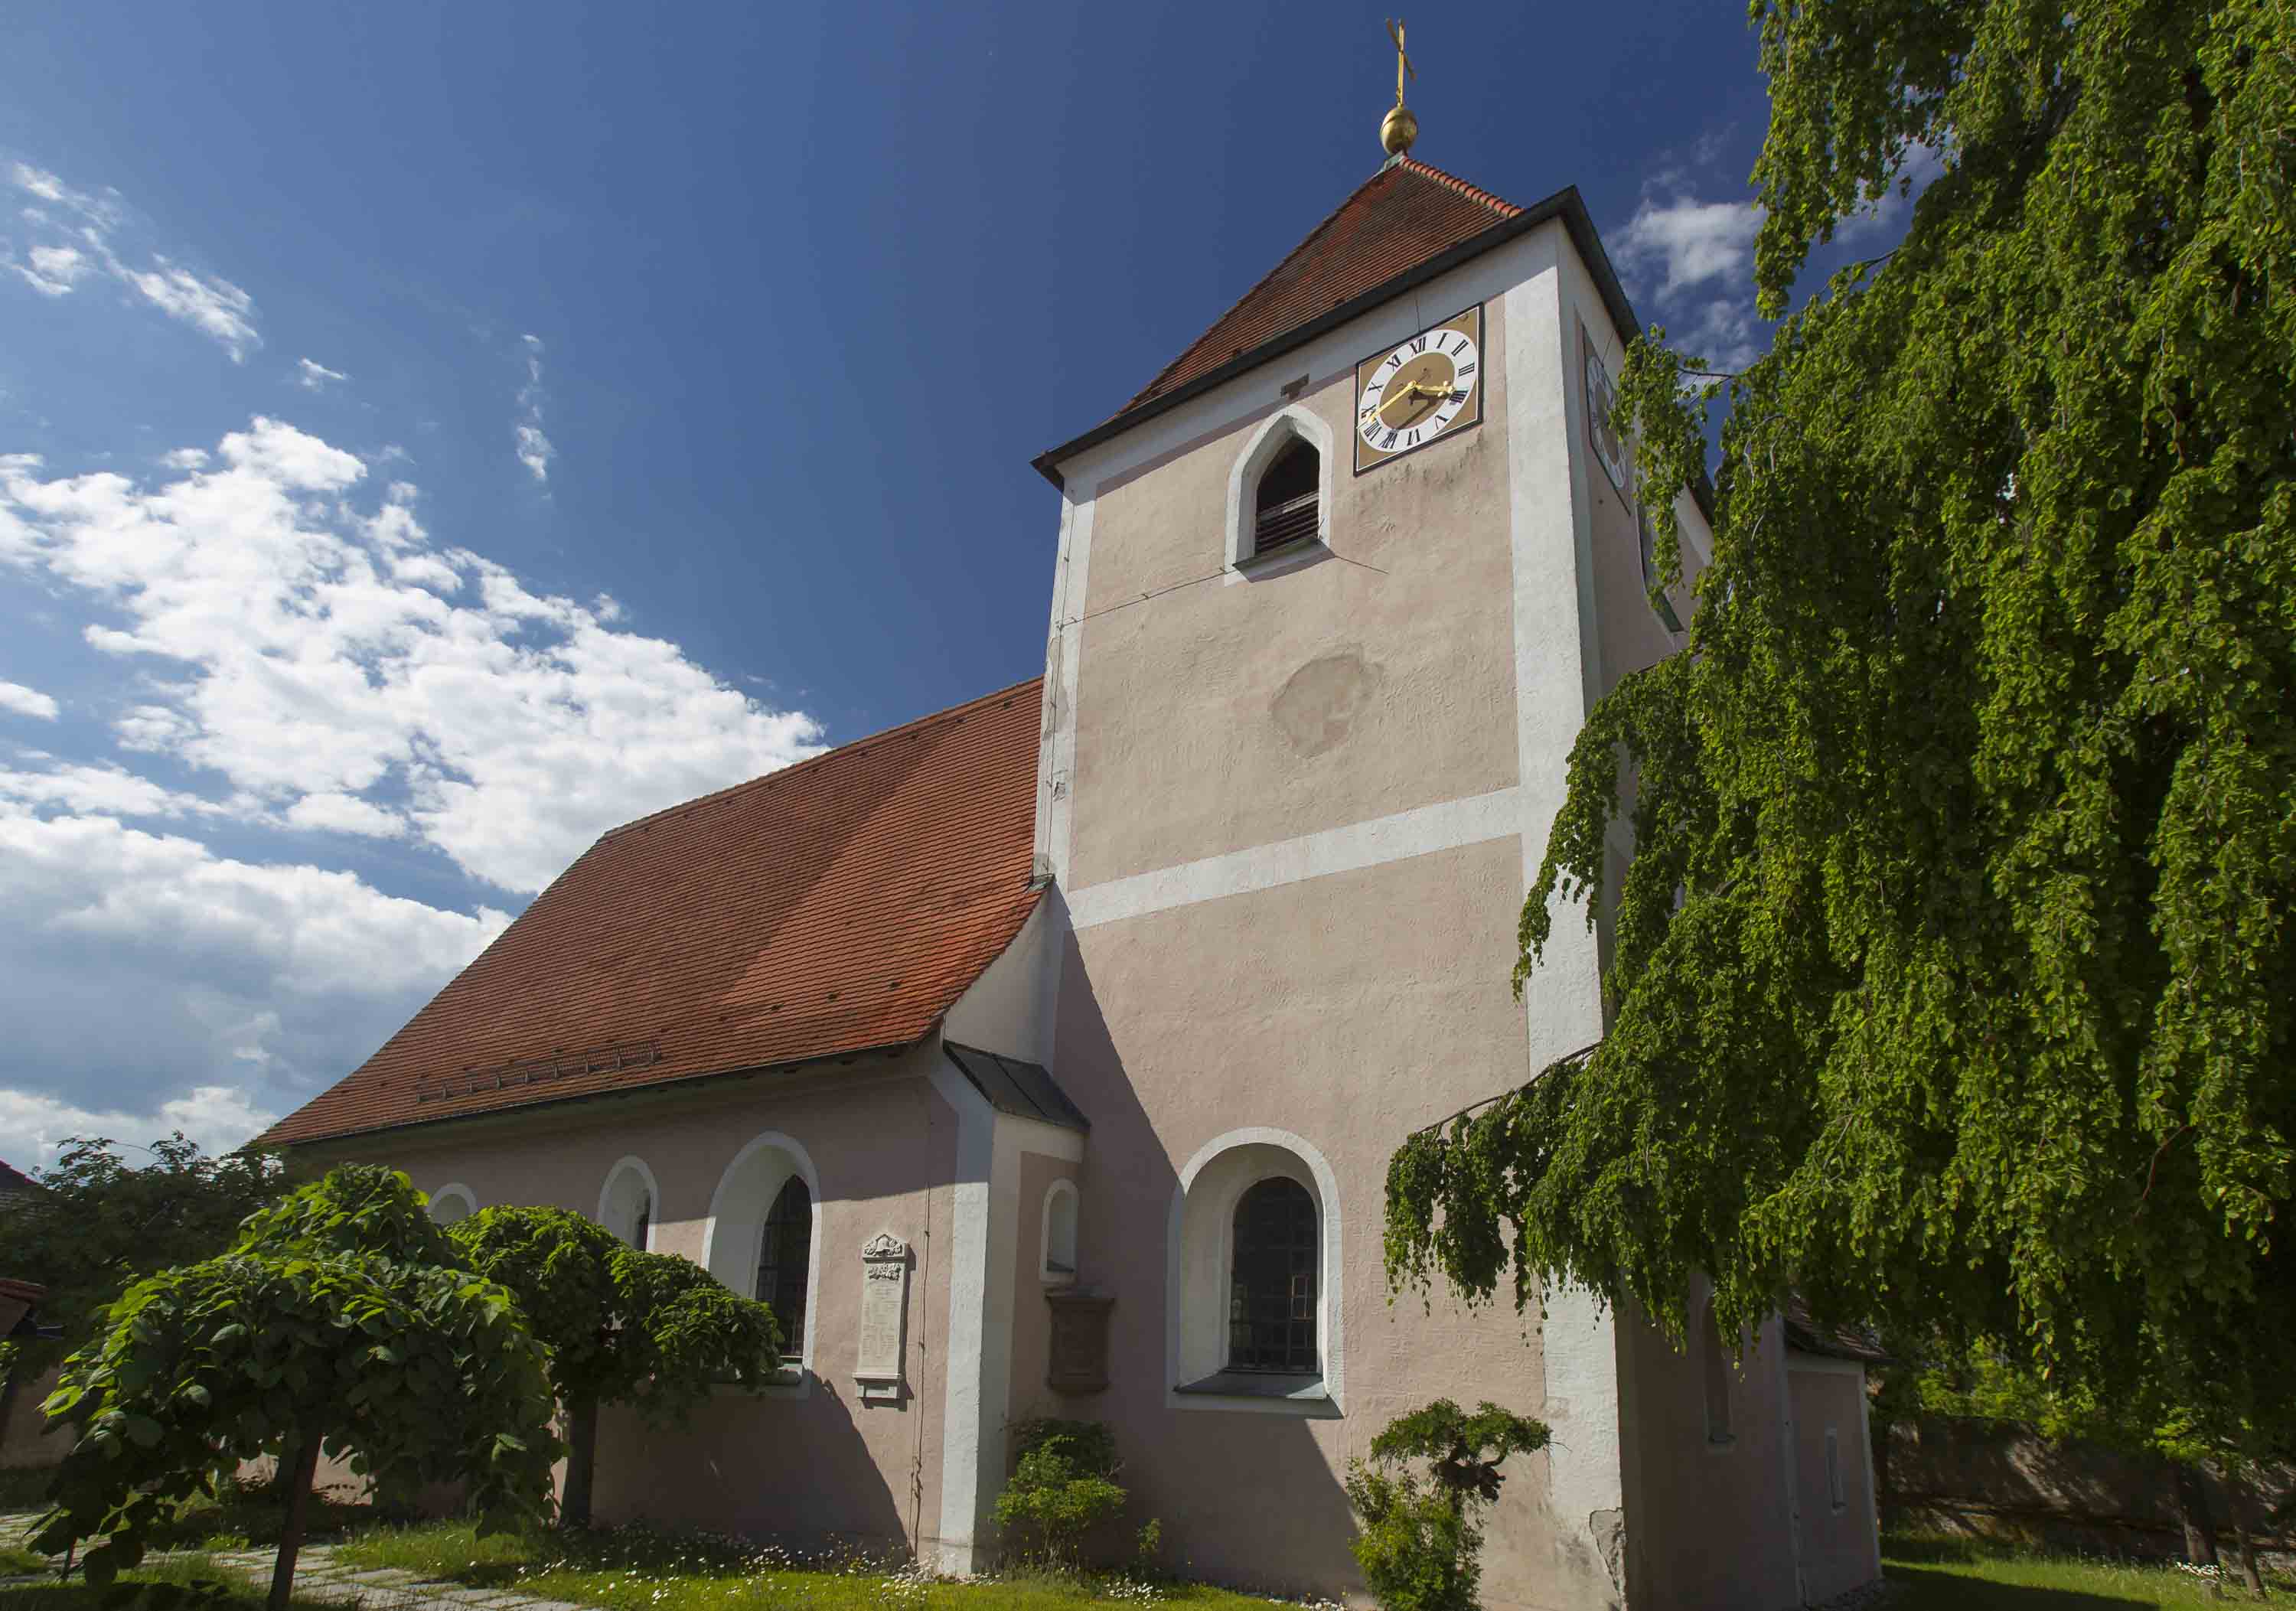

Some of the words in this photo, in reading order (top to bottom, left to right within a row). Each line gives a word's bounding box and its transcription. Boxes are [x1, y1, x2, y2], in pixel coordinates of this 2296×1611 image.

[1410, 337, 1427, 354] XII
[1437, 332, 1447, 348] I
[1451, 339, 1469, 357] II
[1387, 354, 1402, 371] XI
[1458, 361, 1475, 377] III
[1368, 382, 1384, 392] X
[1435, 415, 1449, 429] V
[1407, 429, 1420, 445] VI
